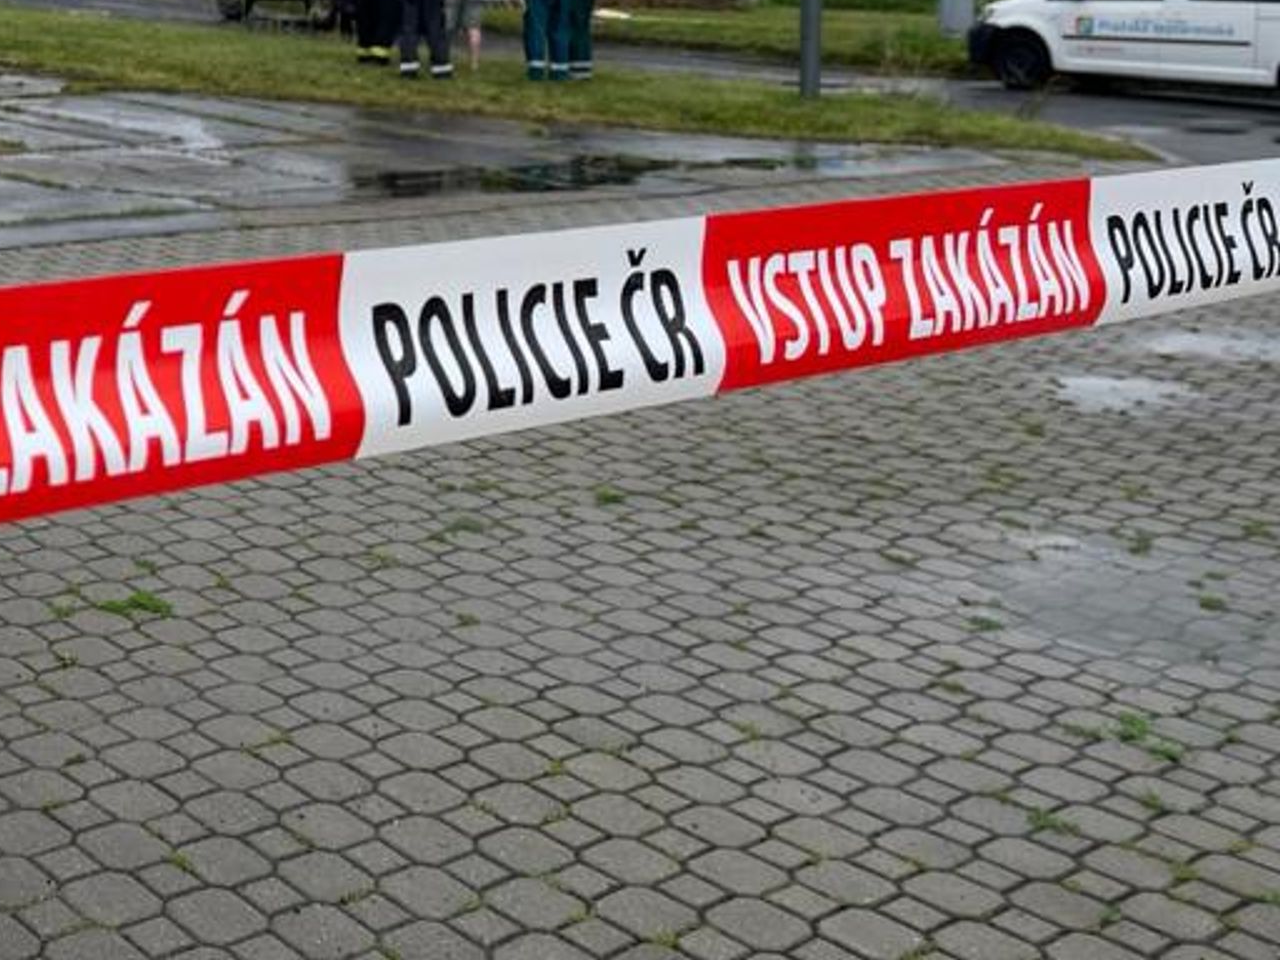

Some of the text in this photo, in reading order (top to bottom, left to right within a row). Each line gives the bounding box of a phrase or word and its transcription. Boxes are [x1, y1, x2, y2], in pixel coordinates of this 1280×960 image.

[727, 202, 1091, 364] VSTUP ZAKÁZÁN
[1106, 180, 1280, 304] POLICIE ČR
[372, 247, 705, 427] POLICIE ČR
